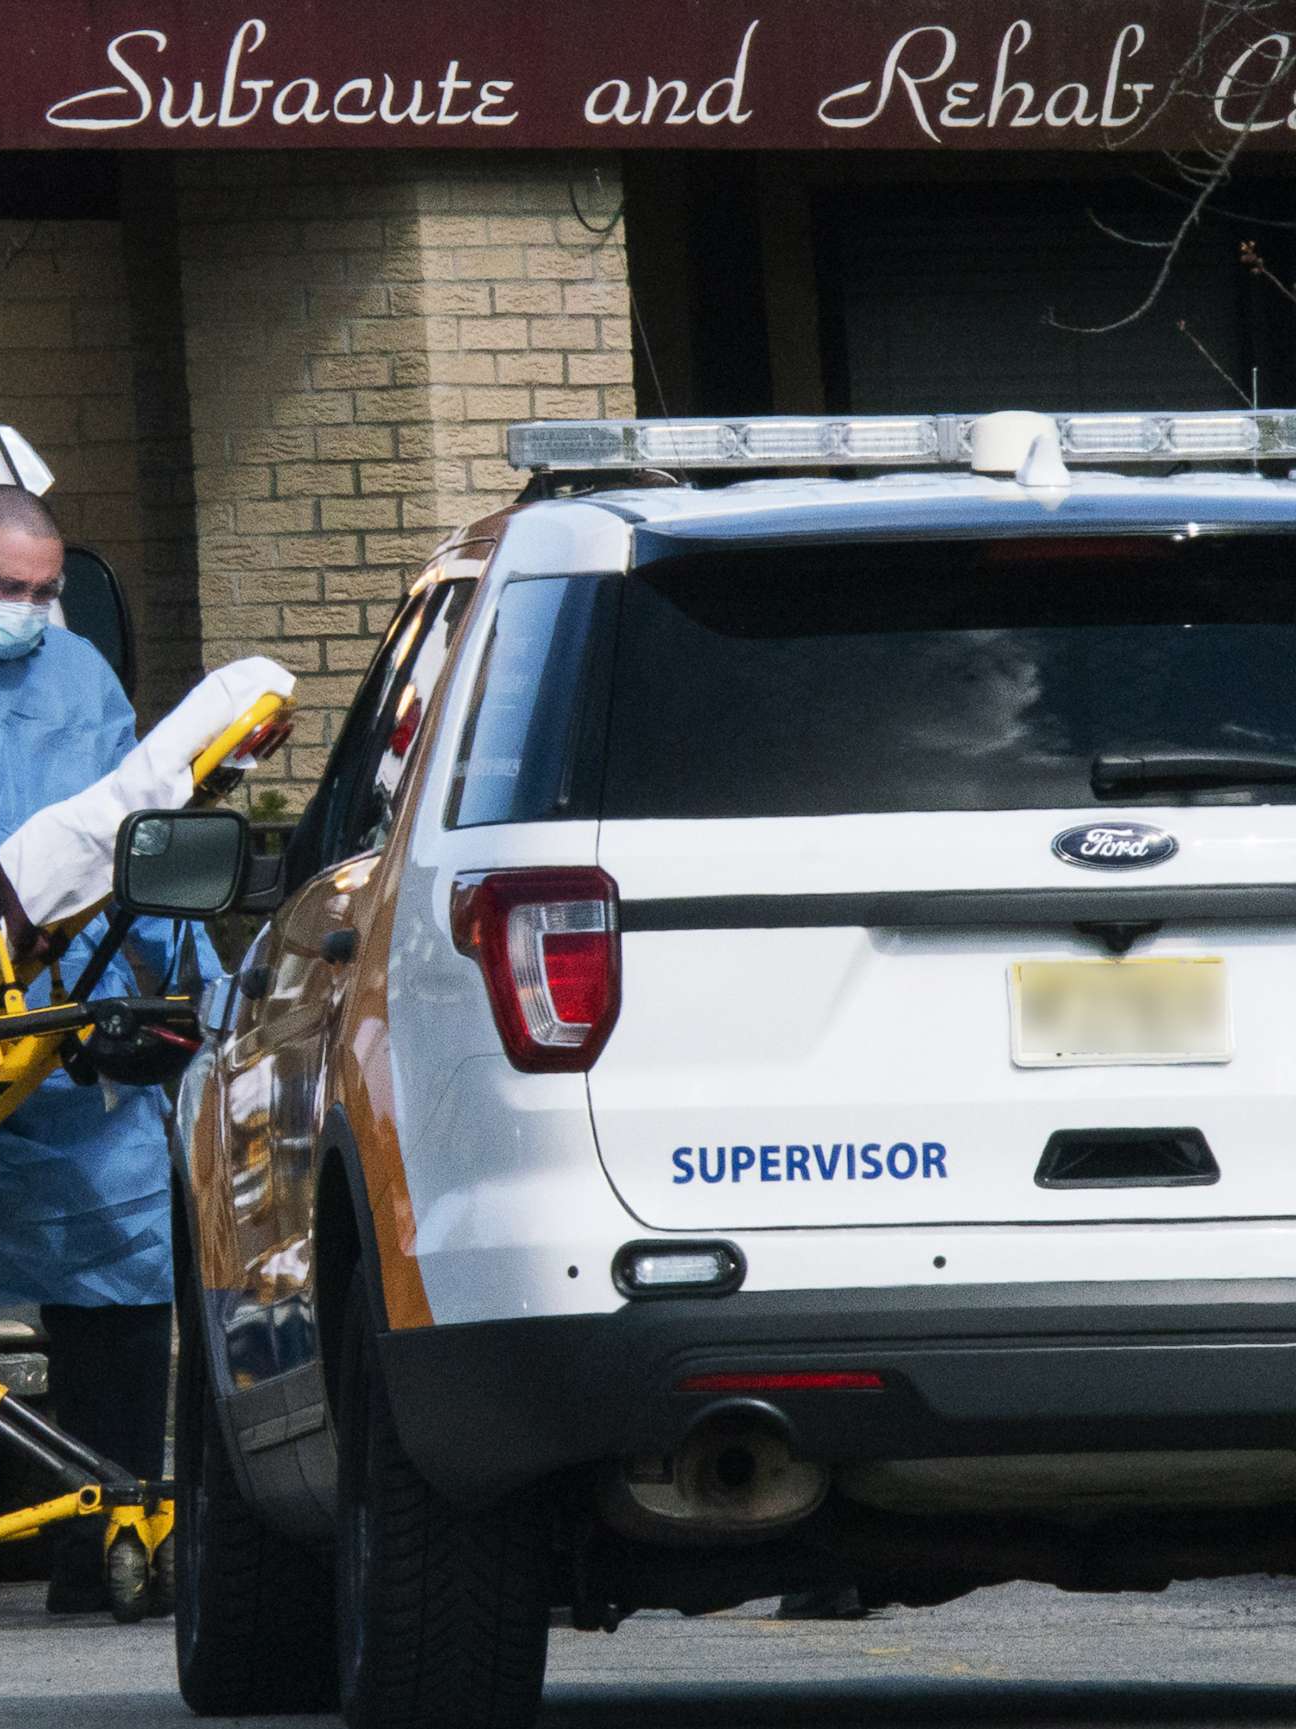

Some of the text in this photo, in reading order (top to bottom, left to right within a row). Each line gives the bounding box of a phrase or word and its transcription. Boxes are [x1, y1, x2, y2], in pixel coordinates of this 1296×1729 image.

[45, 18, 519, 130] Subacute
[584, 19, 759, 125] and
[817, 19, 1154, 143] Rehab
[1214, 33, 1296, 132] C
[1080, 828, 1150, 857] Ford
[671, 1141, 948, 1184] SUPERVISOR
